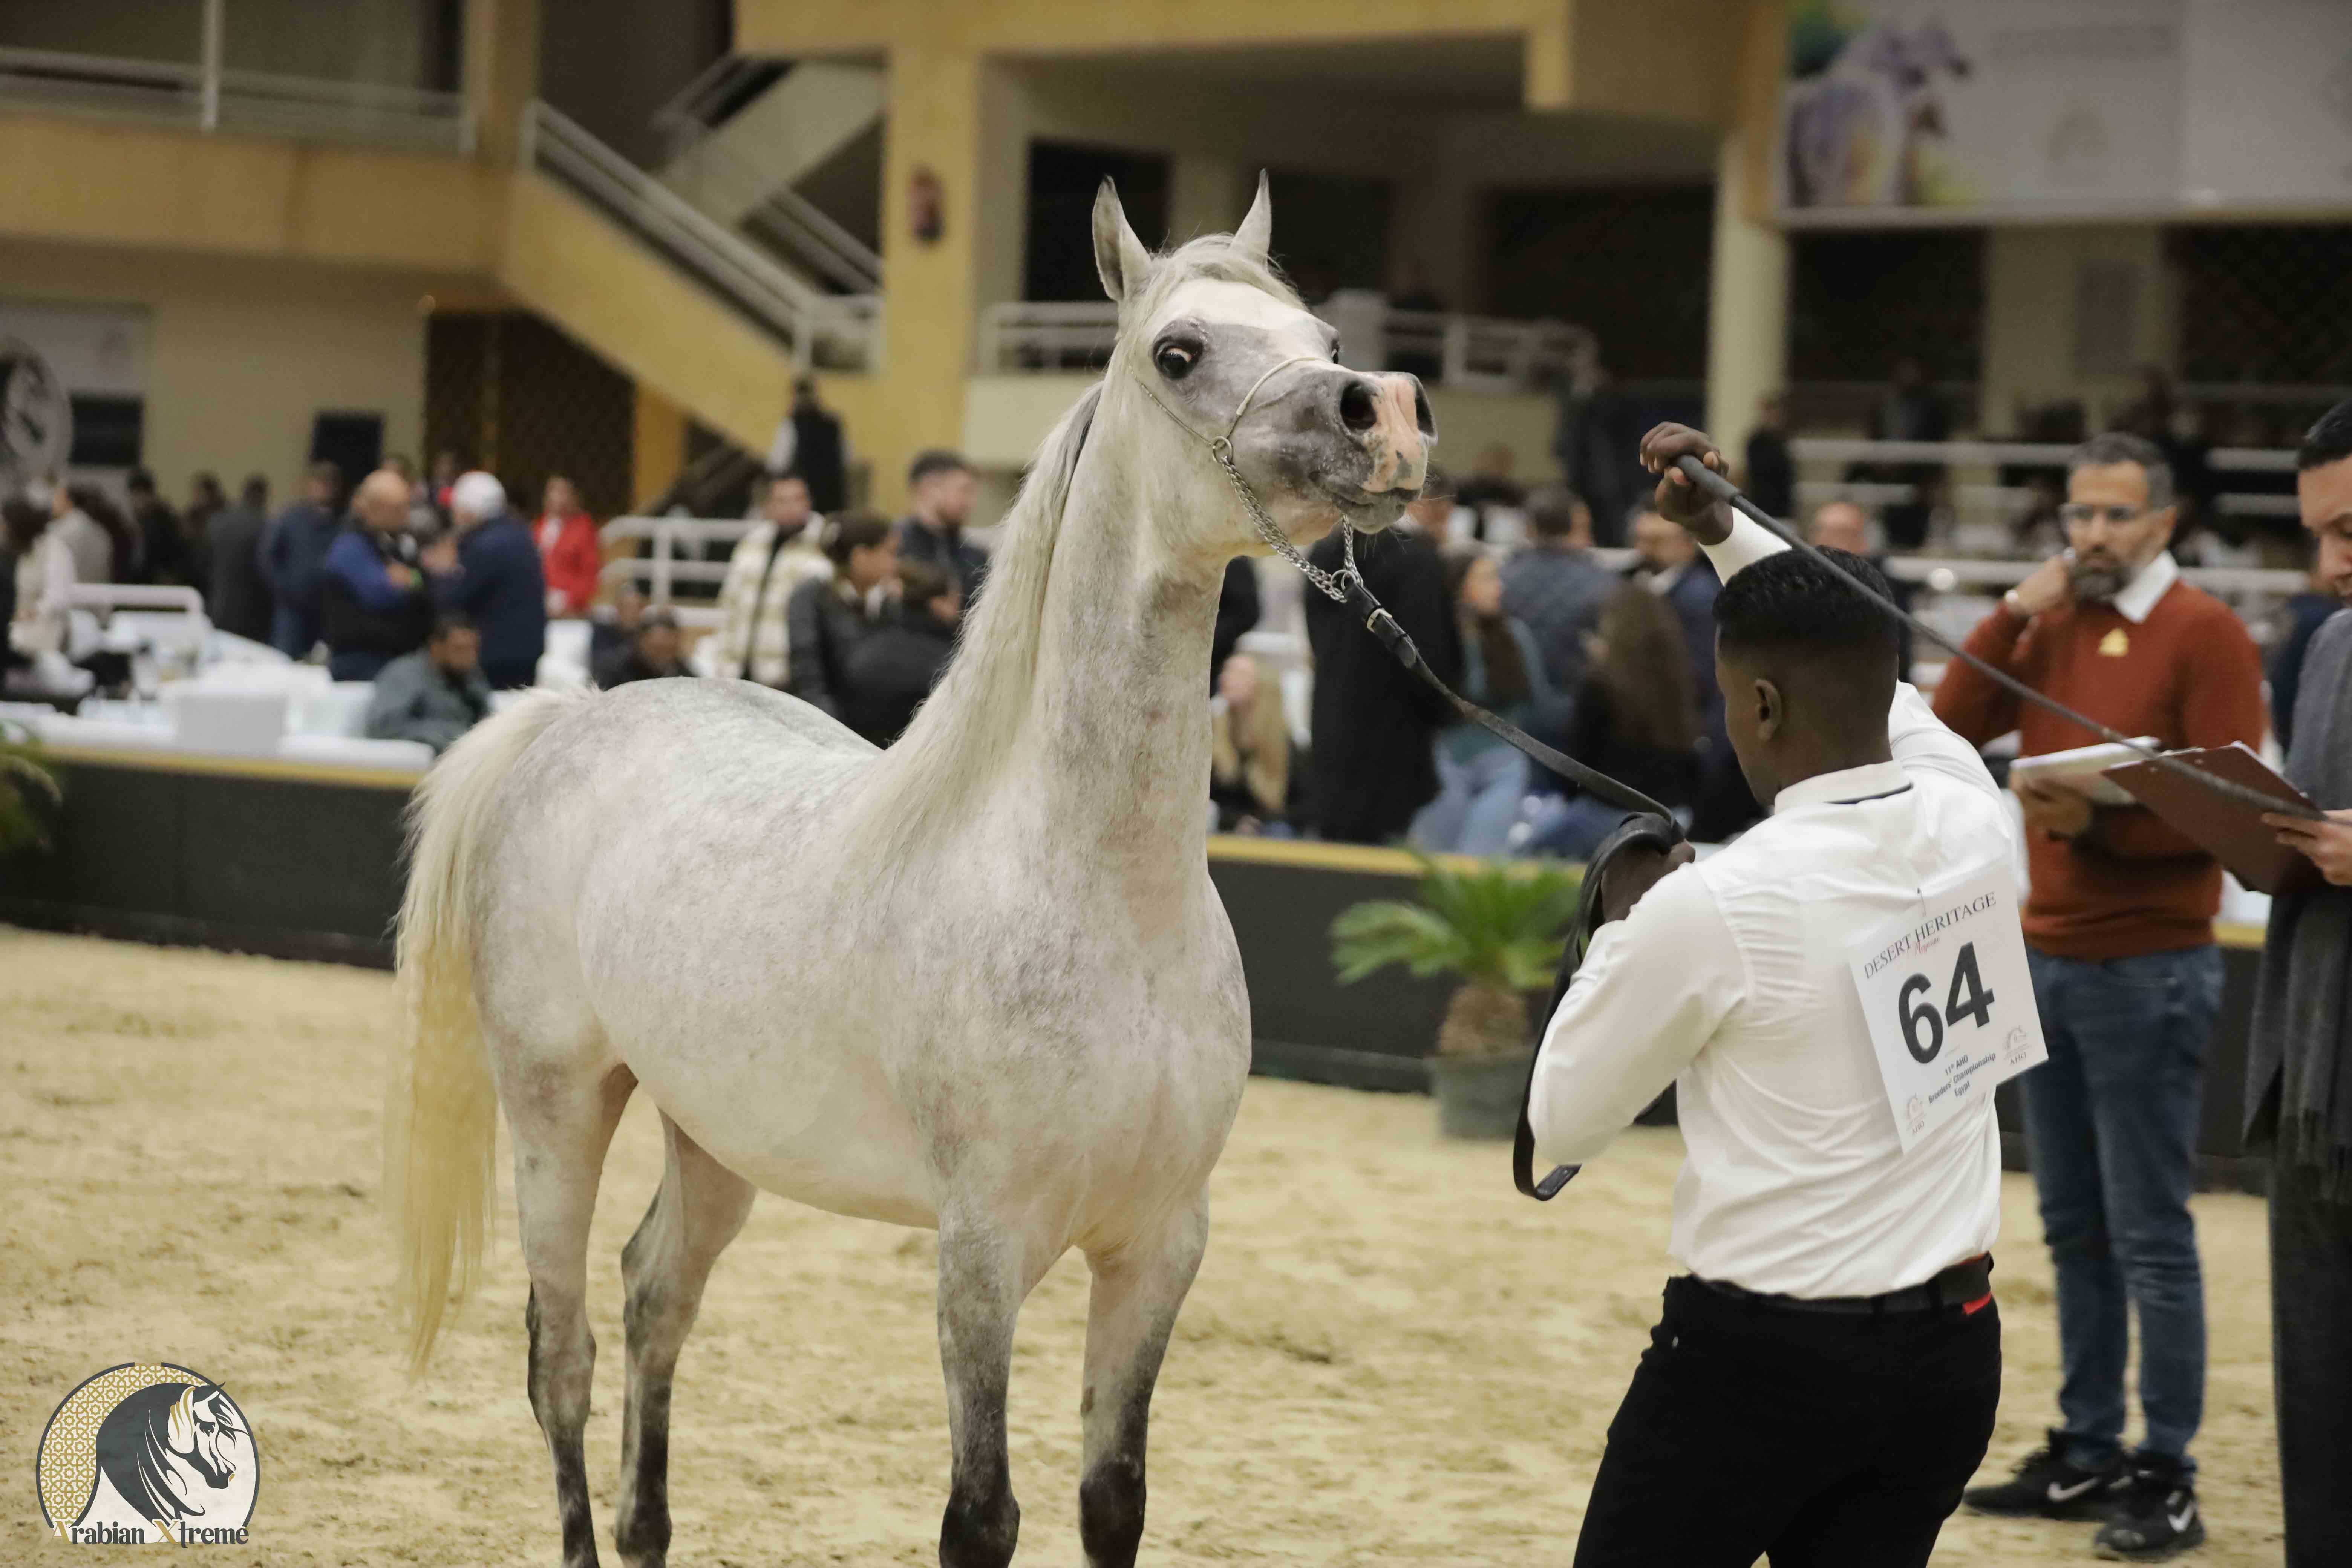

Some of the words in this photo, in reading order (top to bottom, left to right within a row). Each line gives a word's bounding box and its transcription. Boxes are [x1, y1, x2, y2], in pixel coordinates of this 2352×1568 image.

[1864, 934, 1911, 979] DESERT
[1915, 892, 1997, 942] HERITAGE
[1899, 941, 1995, 1064] 64
[1953, 1052, 1996, 1084] Championship
[1956, 1054, 1968, 1069] AHO
[1954, 1080, 1970, 1097] Egypt
